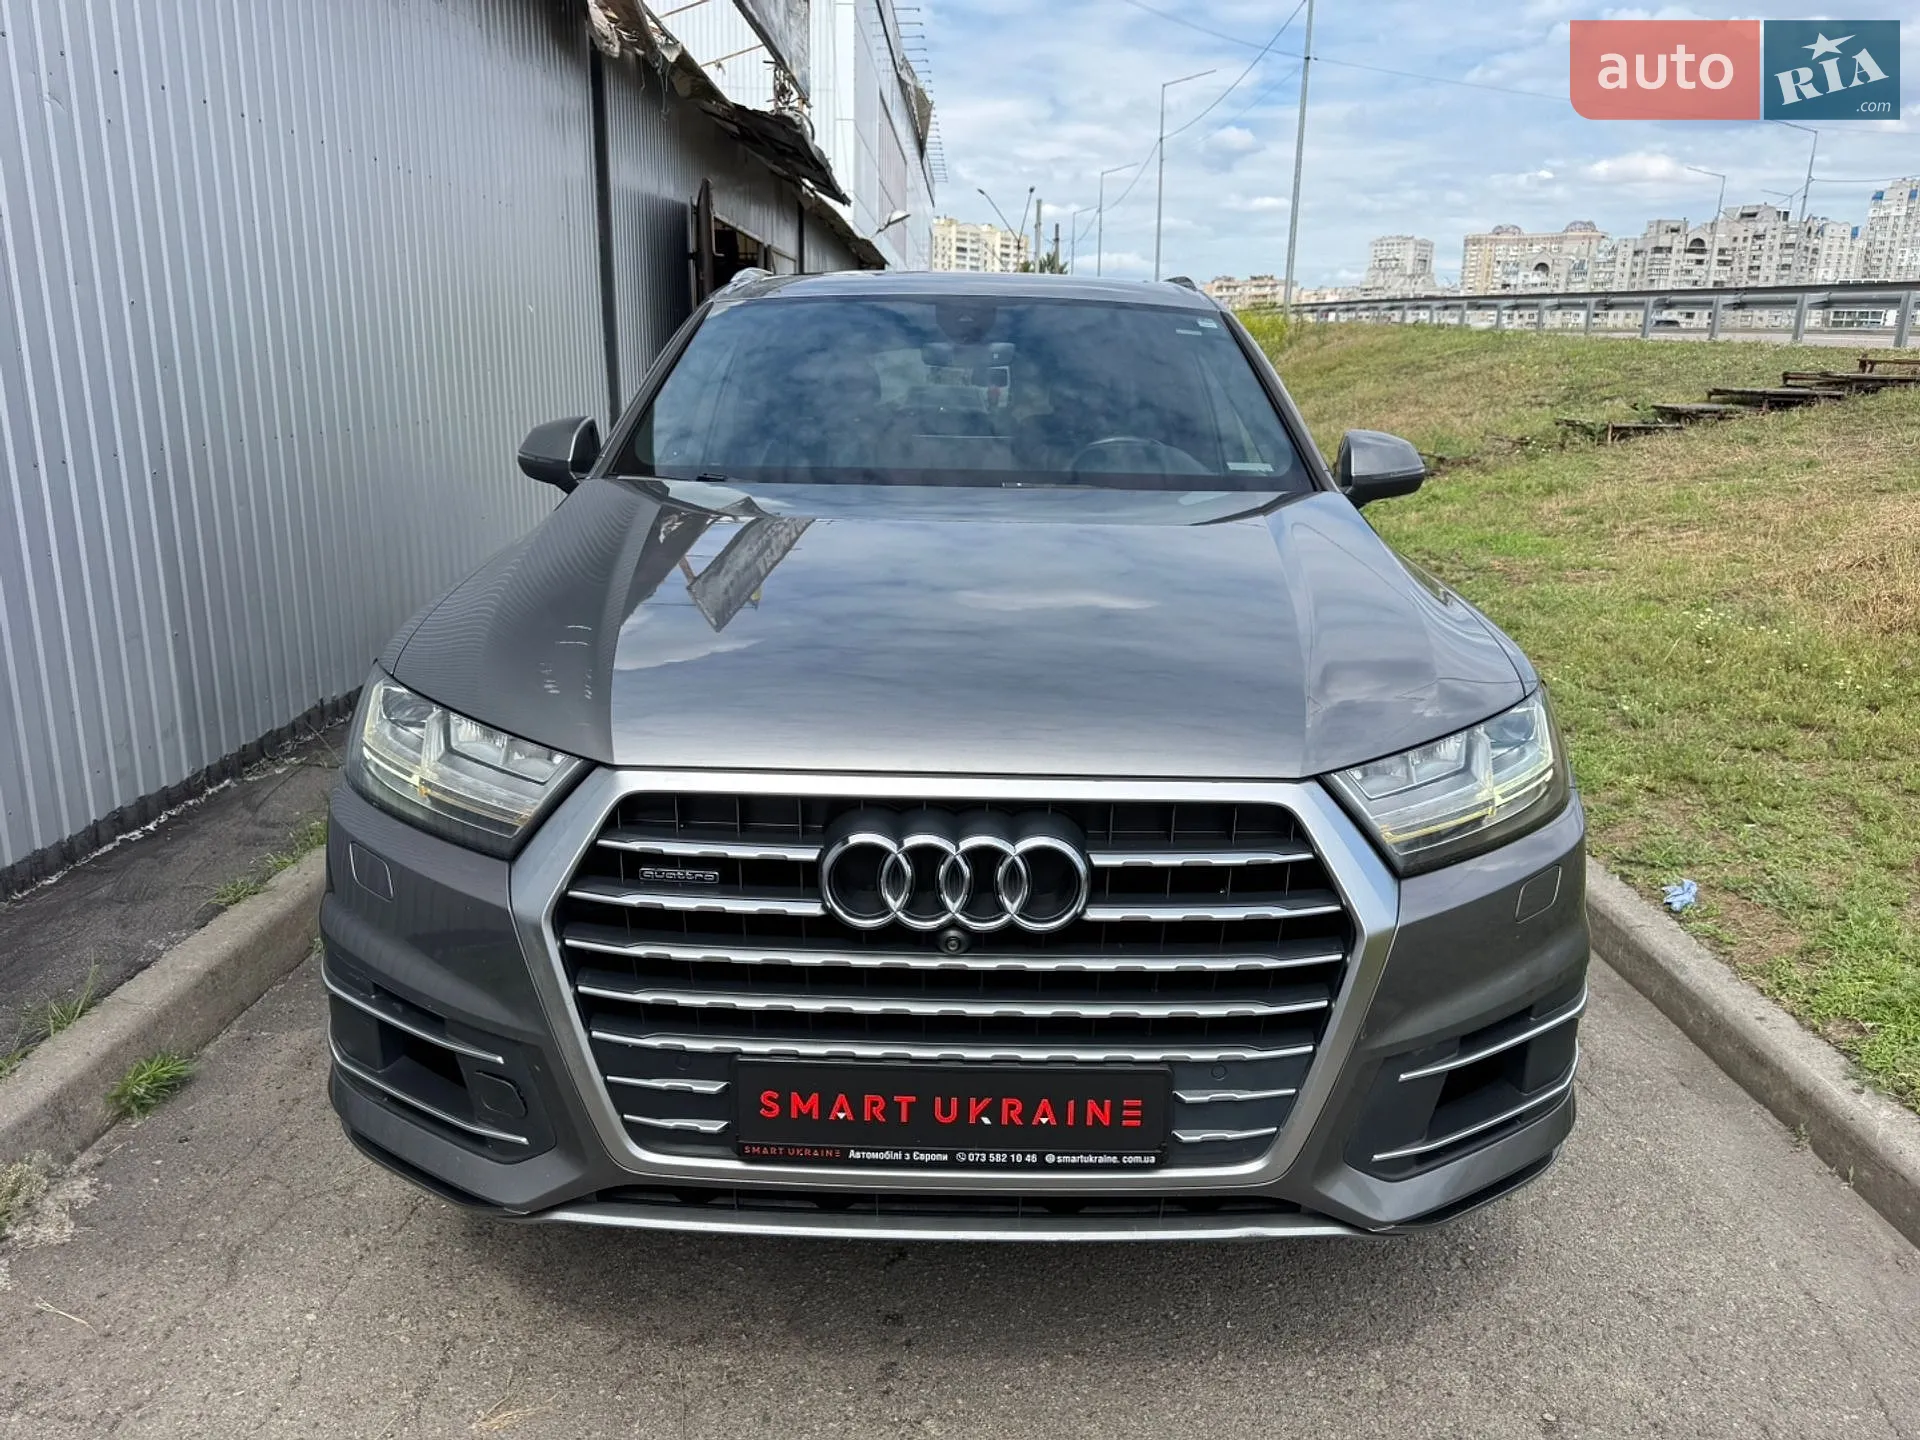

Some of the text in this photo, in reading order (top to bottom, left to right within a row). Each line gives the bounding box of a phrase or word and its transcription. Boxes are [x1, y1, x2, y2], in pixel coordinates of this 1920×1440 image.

[642, 870, 715, 880] quattro
[759, 1090, 1142, 1127] SMART UKRAINE
[744, 1146, 841, 1158] SMART UKRAINE
[848, 1149, 902, 1160] Автомобілі
[913, 1151, 948, 1163] Європи
[968, 1152, 987, 1162] 073
[989, 1153, 1007, 1163] 582
[1010, 1153, 1023, 1163] 10
